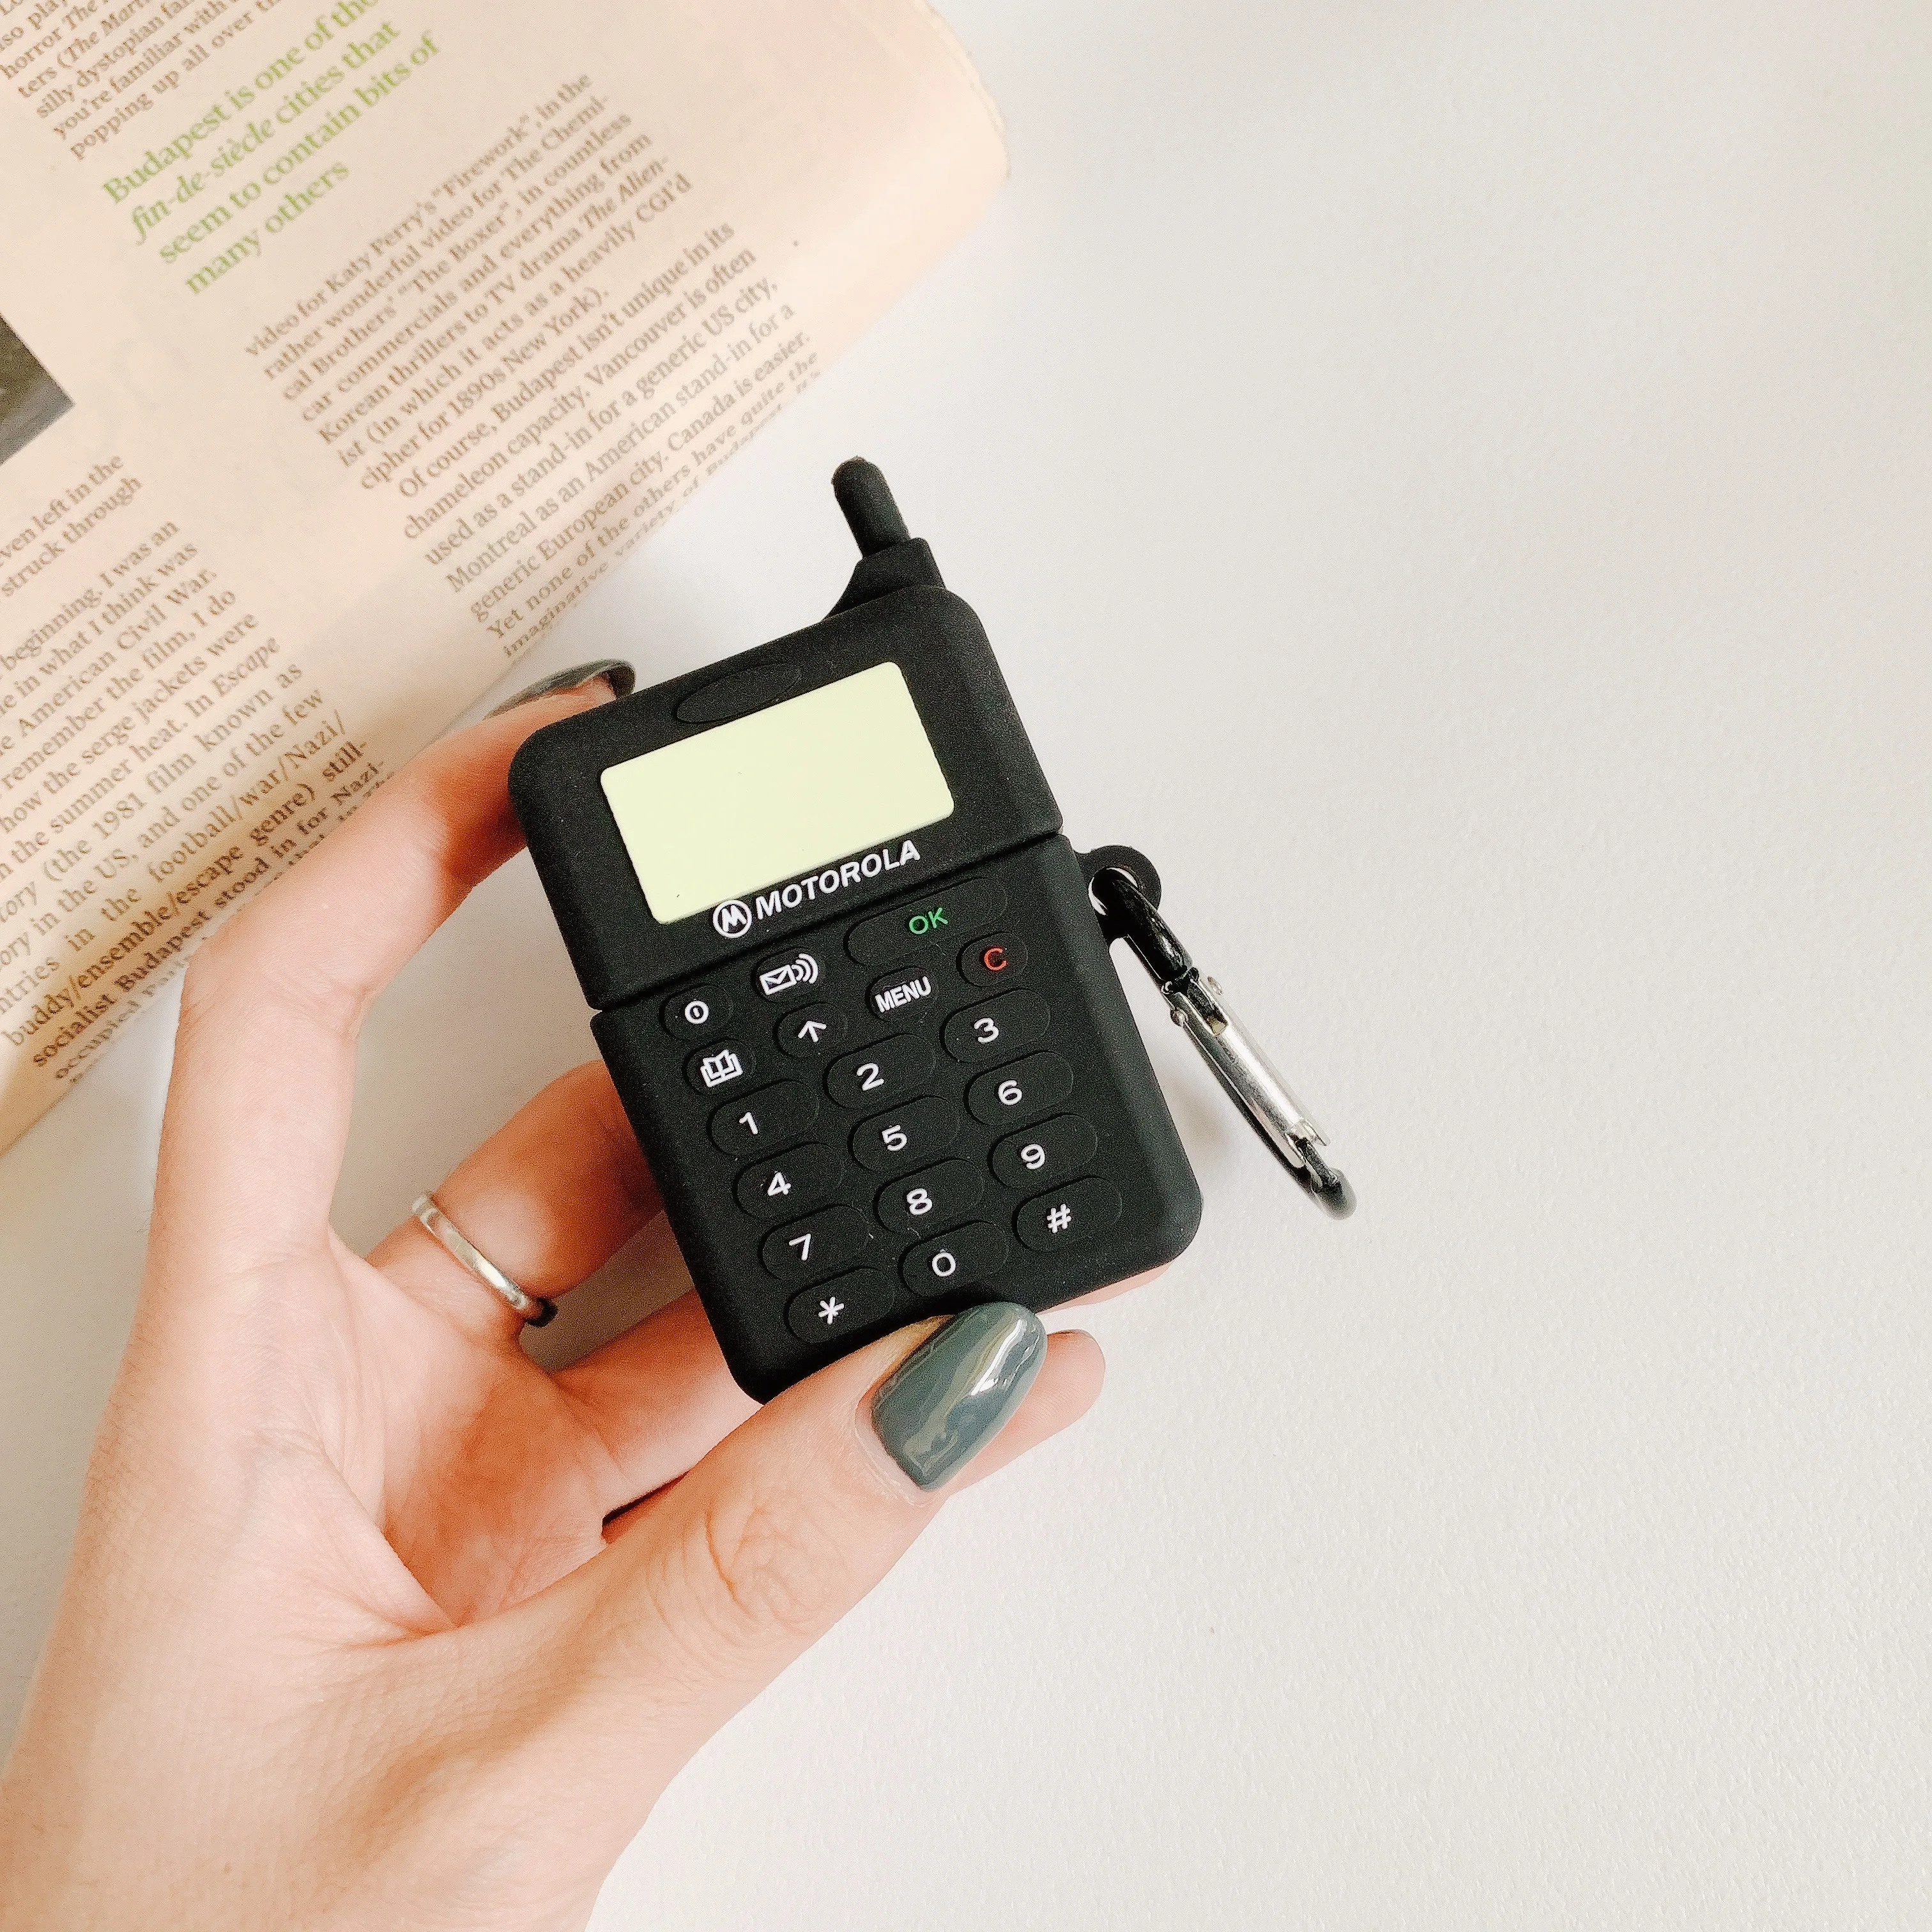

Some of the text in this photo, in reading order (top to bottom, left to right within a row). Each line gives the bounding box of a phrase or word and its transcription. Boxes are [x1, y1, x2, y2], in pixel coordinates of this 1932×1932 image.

[17, 31, 100, 99] ters (The
[35, 15, 165, 119] silly dystopian
[69, 10, 254, 162] popping up all over
[101, 15, 334, 204] Budapest is one of
[108, 32, 183, 95] familiar
[182, 0, 228, 35] with
[275, 66, 345, 125] cities
[341, 22, 400, 70] that
[159, 33, 440, 264] seem to contain bits of
[447, 200, 523, 263] Boxer”,
[543, 114, 632, 187] countless
[185, 229, 262, 295] many
[243, 314, 300, 357] video
[323, 252, 372, 295] Katy
[263, 326, 324, 381] rather
[323, 243, 422, 328] wonderful
[420, 204, 474, 249] video
[499, 149, 542, 183] The
[317, 383, 392, 445] Korean
[386, 320, 468, 387] thrillers
[484, 273, 516, 306] TV
[519, 227, 584, 281] drama
[578, 197, 616, 231] The
[335, 134, 652, 394] commercials and everything from
[398, 364, 463, 416] which
[482, 313, 525, 351] acts
[559, 218, 636, 284] heavily
[360, 286, 610, 490] cipher 1890s New York).
[398, 467, 428, 498] Of
[425, 422, 498, 479] course,
[489, 345, 584, 424] Budapest
[620, 260, 689, 319] unique
[403, 249, 756, 540] chameleon capacity. Vancouver often
[424, 277, 778, 566] used stand-in generic US city,
[30, 456, 124, 533] left the
[443, 510, 539, 594] Montreal
[584, 401, 677, 484] American
[675, 339, 753, 408] stand-in
[470, 555, 541, 624] generic
[535, 482, 631, 563] European
[629, 450, 670, 487] city.
[666, 393, 737, 452] Canada
[753, 331, 811, 383] easier.
[486, 608, 525, 640] Yet
[525, 566, 573, 611] none
[788, 352, 817, 382] the
[1, 477, 142, 597] struck through
[111, 543, 152, 577] was
[13, 543, 198, 699] in what think was
[17, 651, 118, 739] American
[116, 602, 167, 651] Civil
[0, 696, 107, 792] remember
[104, 668, 144, 702] the
[10, 637, 280, 865] the summer heat. In Escape
[42, 614, 257, 795] the serge jackets were
[42, 689, 275, 883] (the 1981 film known
[56, 689, 323, 914] the US, and one of the few
[100, 887, 142, 923] the
[146, 709, 346, 884] football/war/Nazi/
[2, 845, 245, 1047] buddy/ensemble/escape
[249, 782, 316, 848] genre)
[32, 993, 119, 1068] socialist
[112, 910, 213, 993] Budapest
[213, 856, 272, 909] stood
[269, 838, 298, 859] in
[296, 806, 329, 836] for
[755, 840, 920, 919] MOTOROLA
[909, 907, 949, 935] OK
[875, 976, 931, 1013] MENU
[984, 947, 1008, 971] C
[857, 1063, 885, 1091] 2
[974, 1018, 999, 1044] 3
[999, 1080, 1023, 1106] 6
[739, 1112, 758, 1135] 1
[767, 1172, 792, 1197] 4
[882, 1125, 908, 1151] 5
[1021, 1144, 1046, 1170] 9
[789, 1234, 811, 1261] 7
[907, 1188, 933, 1216] 8
[1047, 1204, 1072, 1234] #
